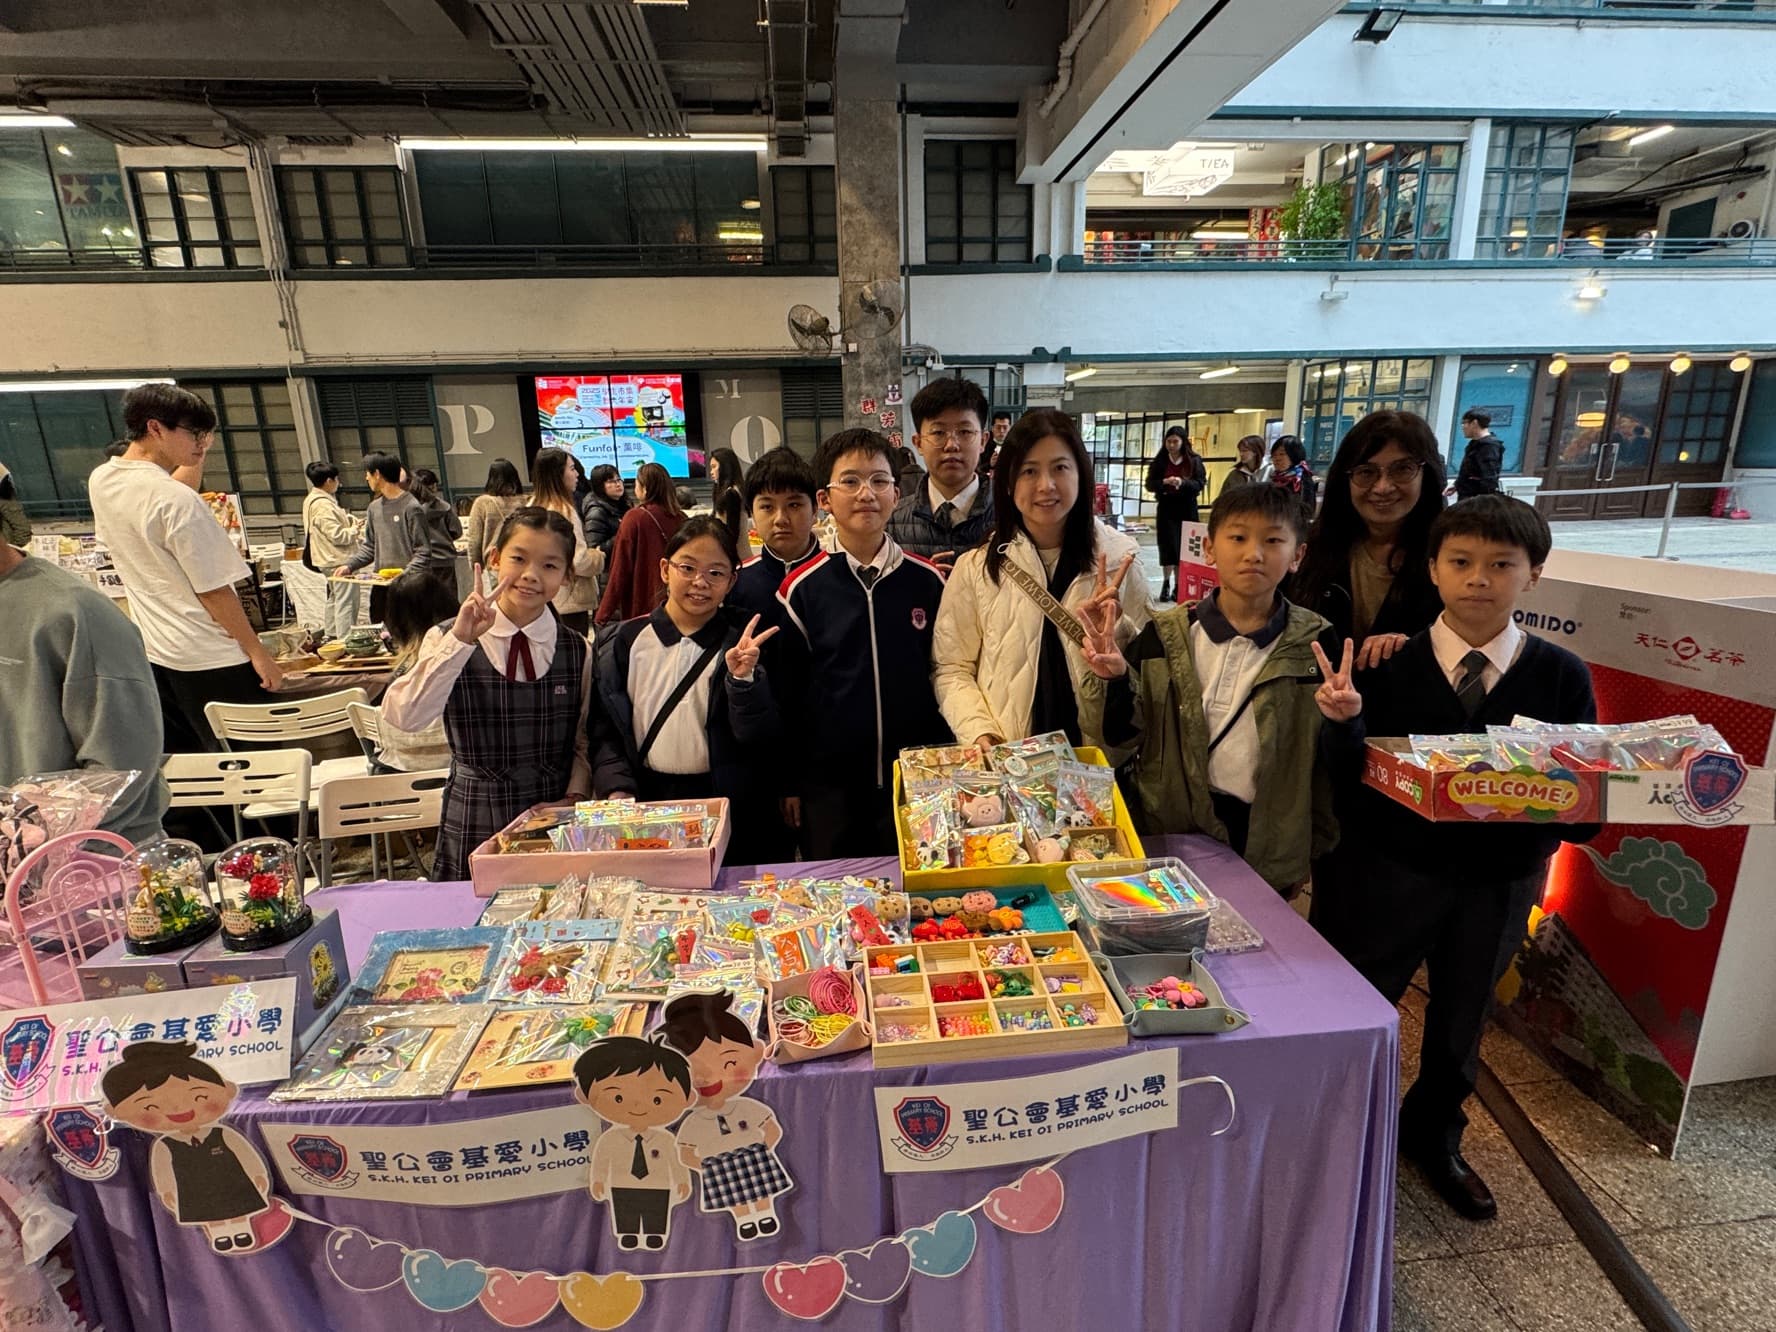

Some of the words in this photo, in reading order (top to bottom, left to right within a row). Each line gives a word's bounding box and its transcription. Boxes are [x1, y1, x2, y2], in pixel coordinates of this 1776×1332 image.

[716, 379, 741, 398] M
[437, 405, 495, 454] P
[1021, 577, 1058, 613] LOEWE
[1634, 632, 1669, 650] 天仁
[1703, 648, 1746, 667] 茗茶
[1454, 779, 1573, 804] WELCOME!
[229, 1040, 284, 1056] SCHOOL
[961, 1074, 1166, 1132] 聖公會基愛小學
[966, 1133, 1006, 1144] S.K.H.
[1009, 1129, 1032, 1140] KEI
[1037, 1125, 1053, 1135] OI
[1057, 1112, 1113, 1132] PRIMARY
[1119, 1099, 1169, 1116] SCHOOL
[360, 1130, 590, 1172] 聖公會基愛小學
[368, 1173, 409, 1184] S.K.H.
[413, 1172, 438, 1184] KEI
[443, 1173, 461, 1184] OI
[465, 1165, 532, 1182] PRIMARY
